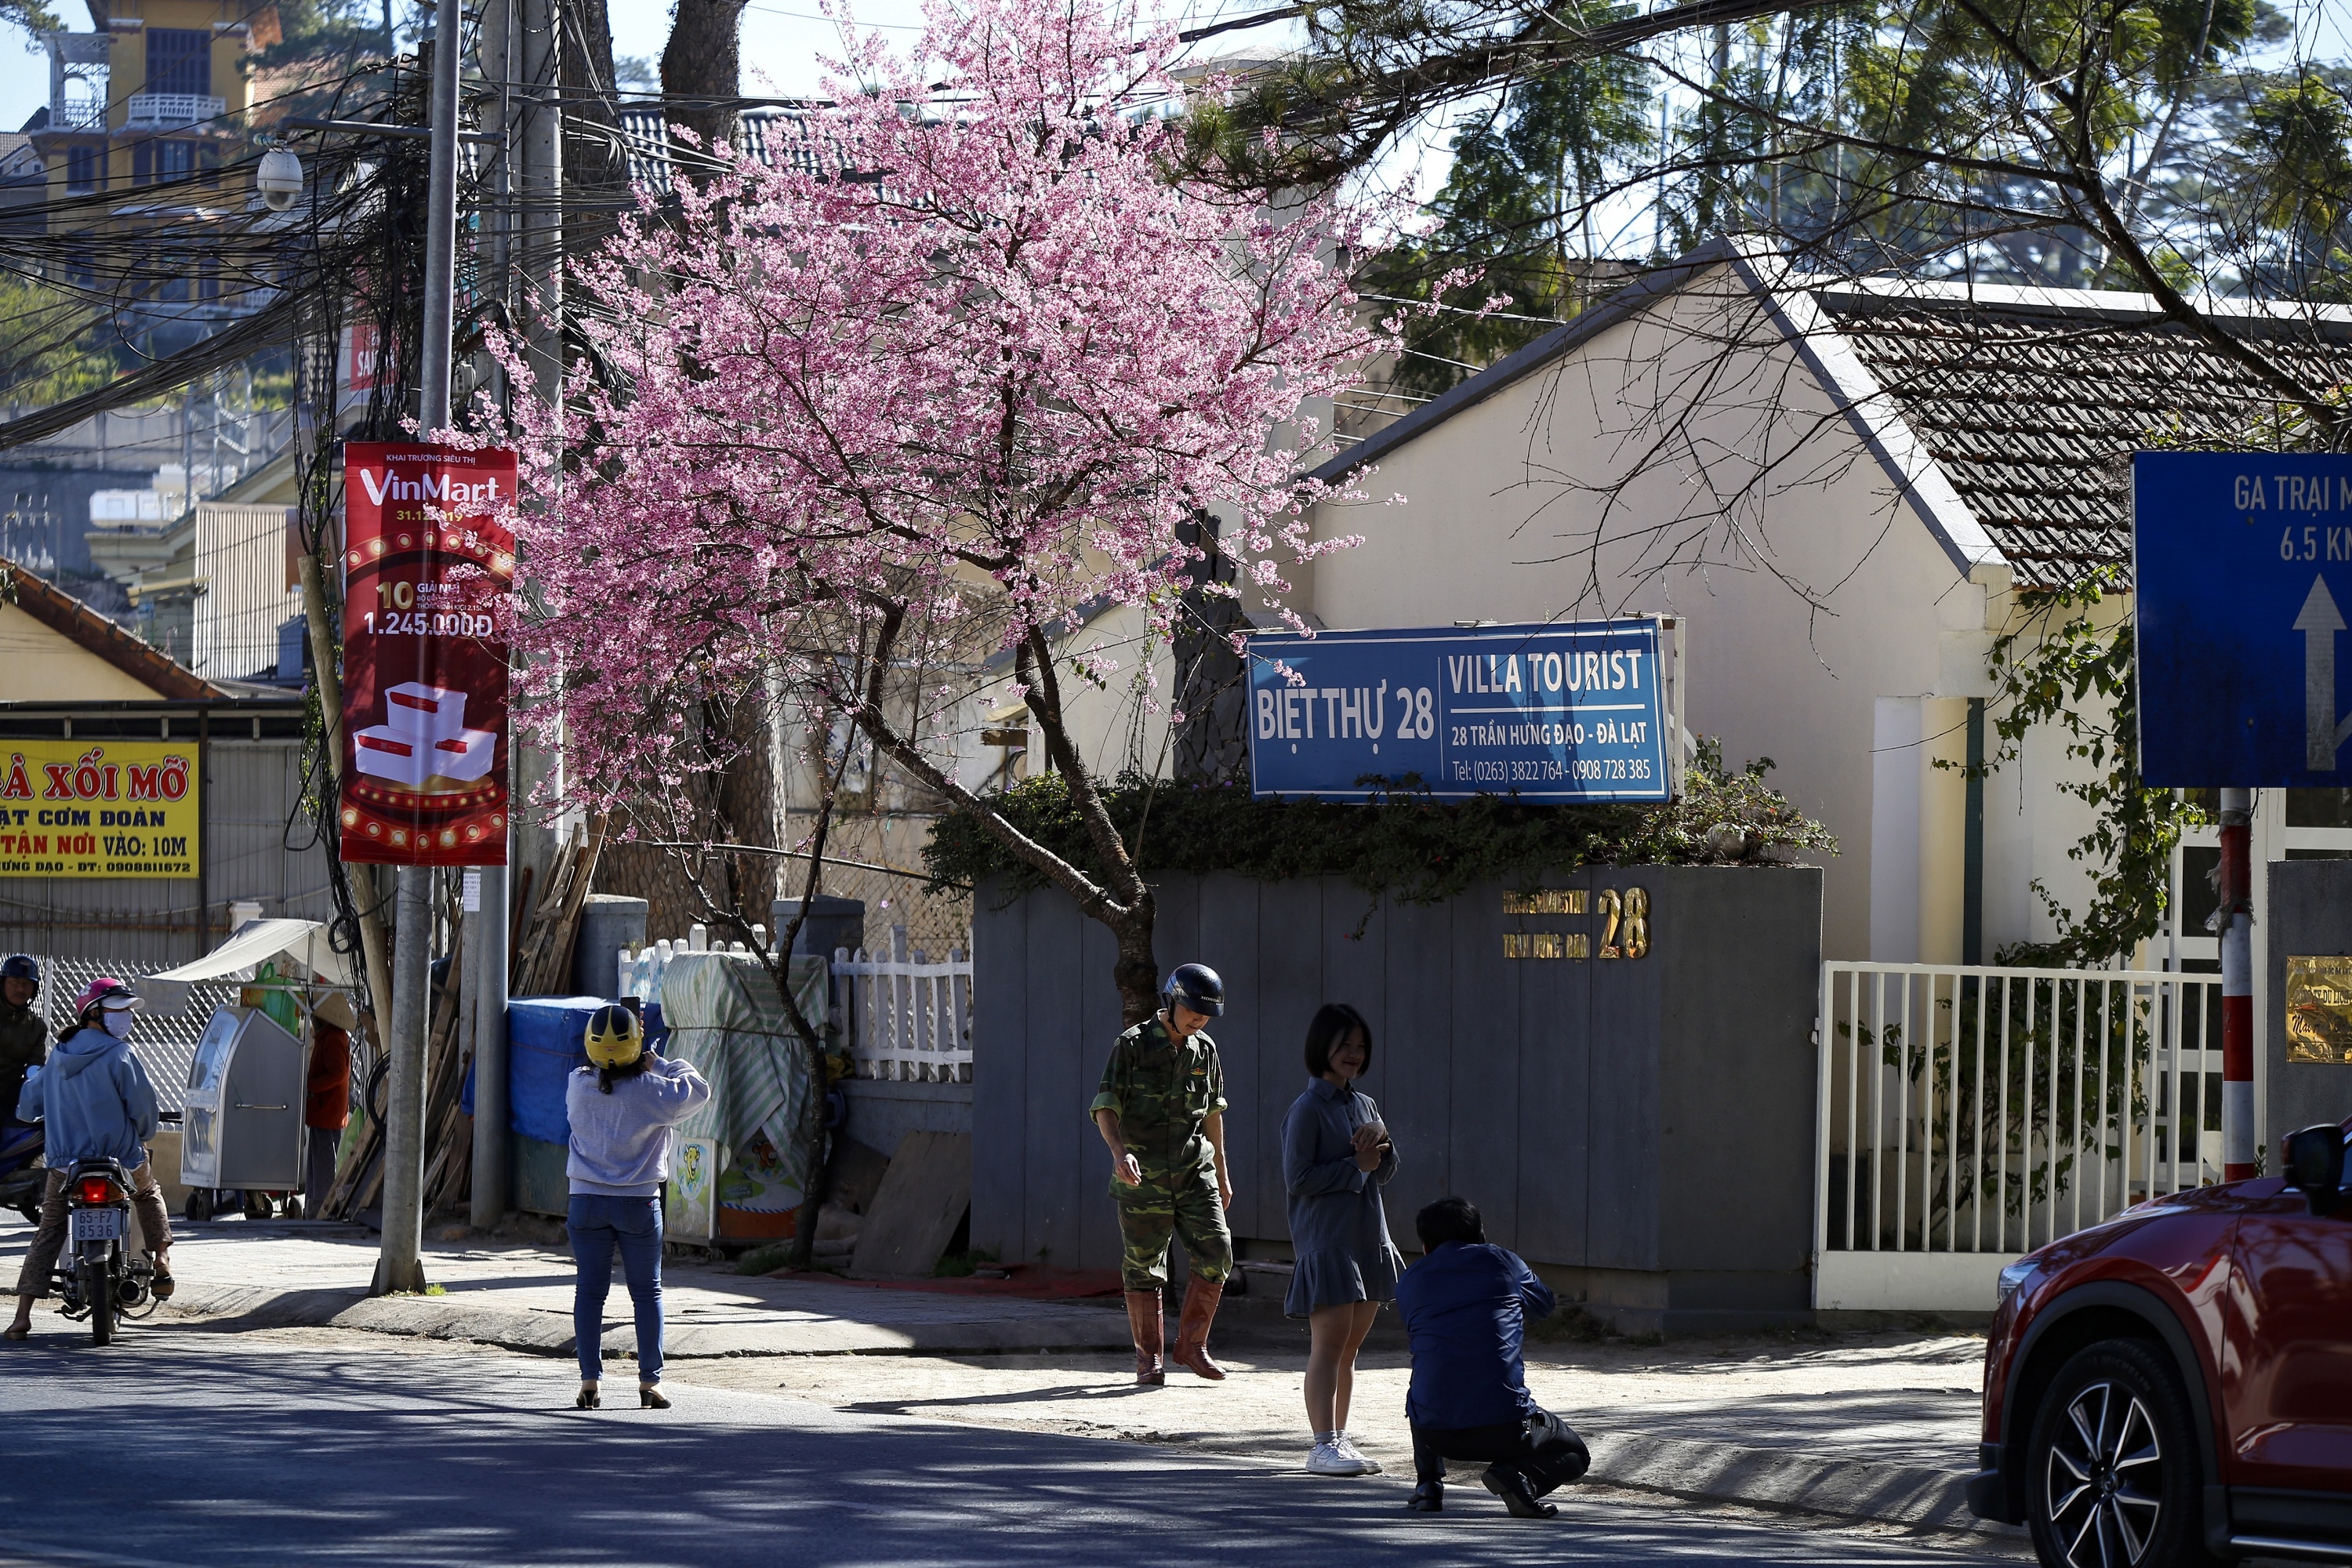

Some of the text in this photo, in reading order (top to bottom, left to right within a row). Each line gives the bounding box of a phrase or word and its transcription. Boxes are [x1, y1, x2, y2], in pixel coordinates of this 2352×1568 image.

[443, 454, 460, 463] SIÊU
[463, 456, 476, 466] THỊ
[360, 468, 499, 506] VinMart
[2234, 475, 2266, 510] GA
[2274, 476, 2329, 517] TRẠI
[2281, 526, 2317, 561] 6.5
[376, 581, 414, 610] 10
[417, 580, 437, 593] GIẢI
[364, 612, 492, 637] 1.245.000Đ
[1449, 648, 1642, 694] VILLA TOURIST
[1257, 677, 1435, 755] BIỆT THỰ 28
[1452, 726, 1468, 746] 28
[1470, 719, 1506, 746] TRẦN
[1510, 722, 1550, 746] HƯNG
[1554, 723, 1584, 750] ĐẠO
[1596, 718, 1617, 744] ĐÀ
[1621, 721, 1646, 750] LẠT
[0, 747, 190, 802] À XỐI MỠ
[1453, 760, 1472, 780] Tel:
[1475, 760, 1508, 783] (0263)
[1512, 760, 1538, 780] 3822
[1541, 760, 1563, 780] 764
[1572, 760, 1600, 780] 0908
[1603, 759, 1626, 779] 728
[1628, 759, 1650, 779] 385
[38, 806, 91, 826] CƠM
[100, 806, 165, 827] ĐOÀN
[0, 829, 187, 859] TẬN NƠI VÀO: 10M
[107, 862, 191, 873] 0908811672
[1598, 887, 1647, 959] 28
[79, 1211, 113, 1224] 65-F7
[79, 1225, 113, 1238] 8536
